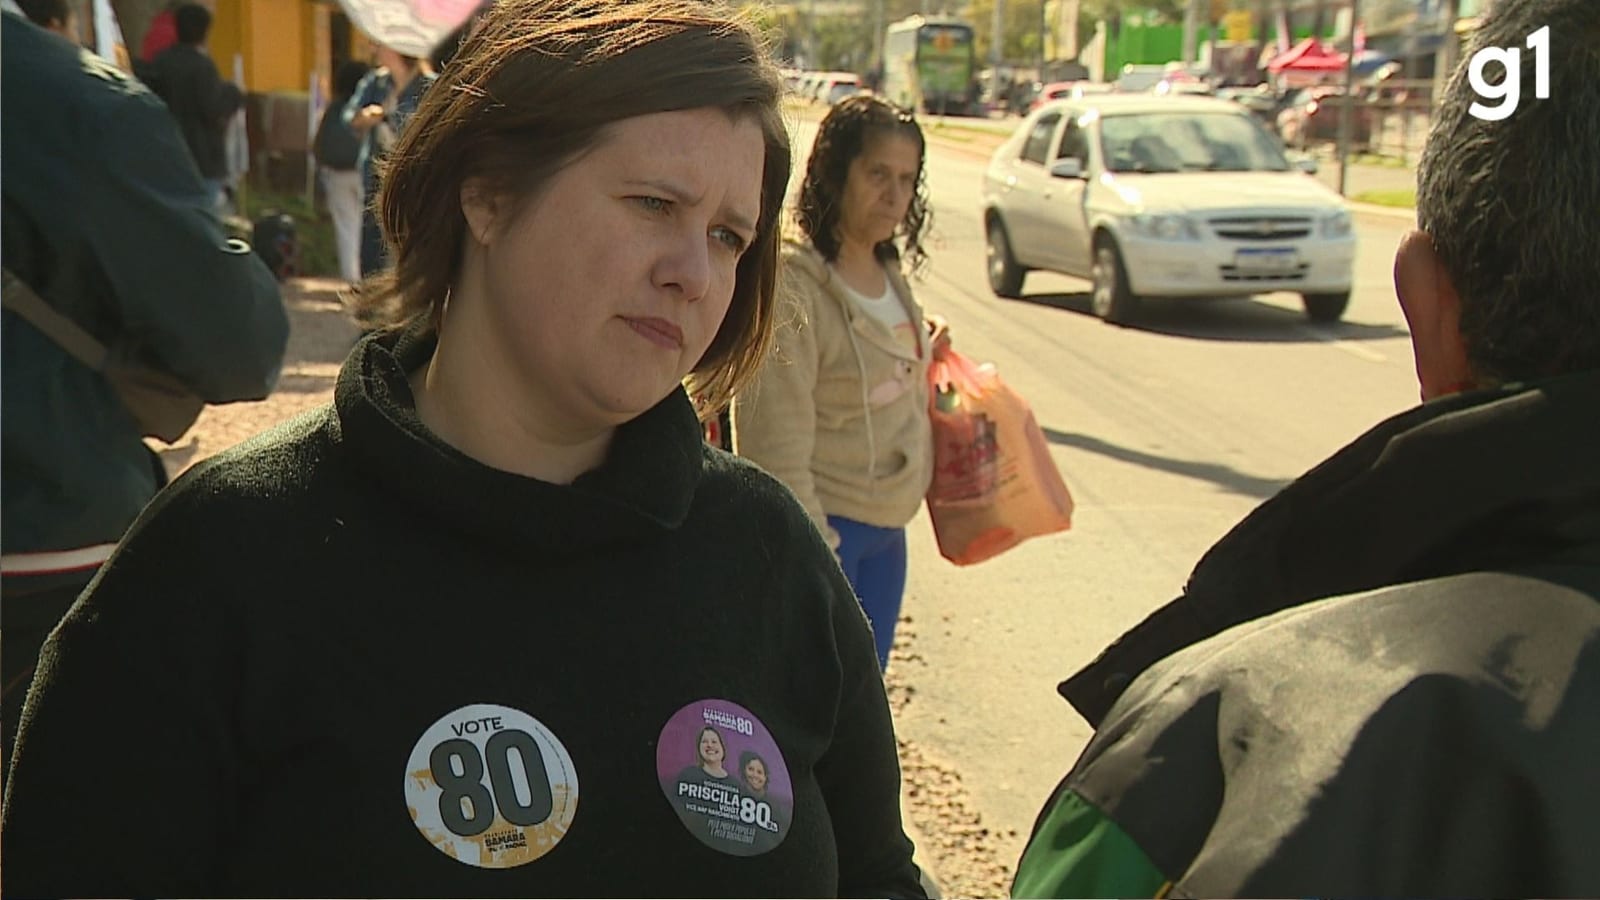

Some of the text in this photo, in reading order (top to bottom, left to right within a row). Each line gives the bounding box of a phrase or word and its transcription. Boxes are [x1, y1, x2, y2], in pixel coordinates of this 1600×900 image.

[451, 717, 504, 737] VOTE
[737, 717, 753, 736] 80
[429, 728, 553, 837] 80
[678, 782, 740, 807] PRISCILA
[719, 804, 740, 815] VOIGT
[740, 797, 772, 829] 80
